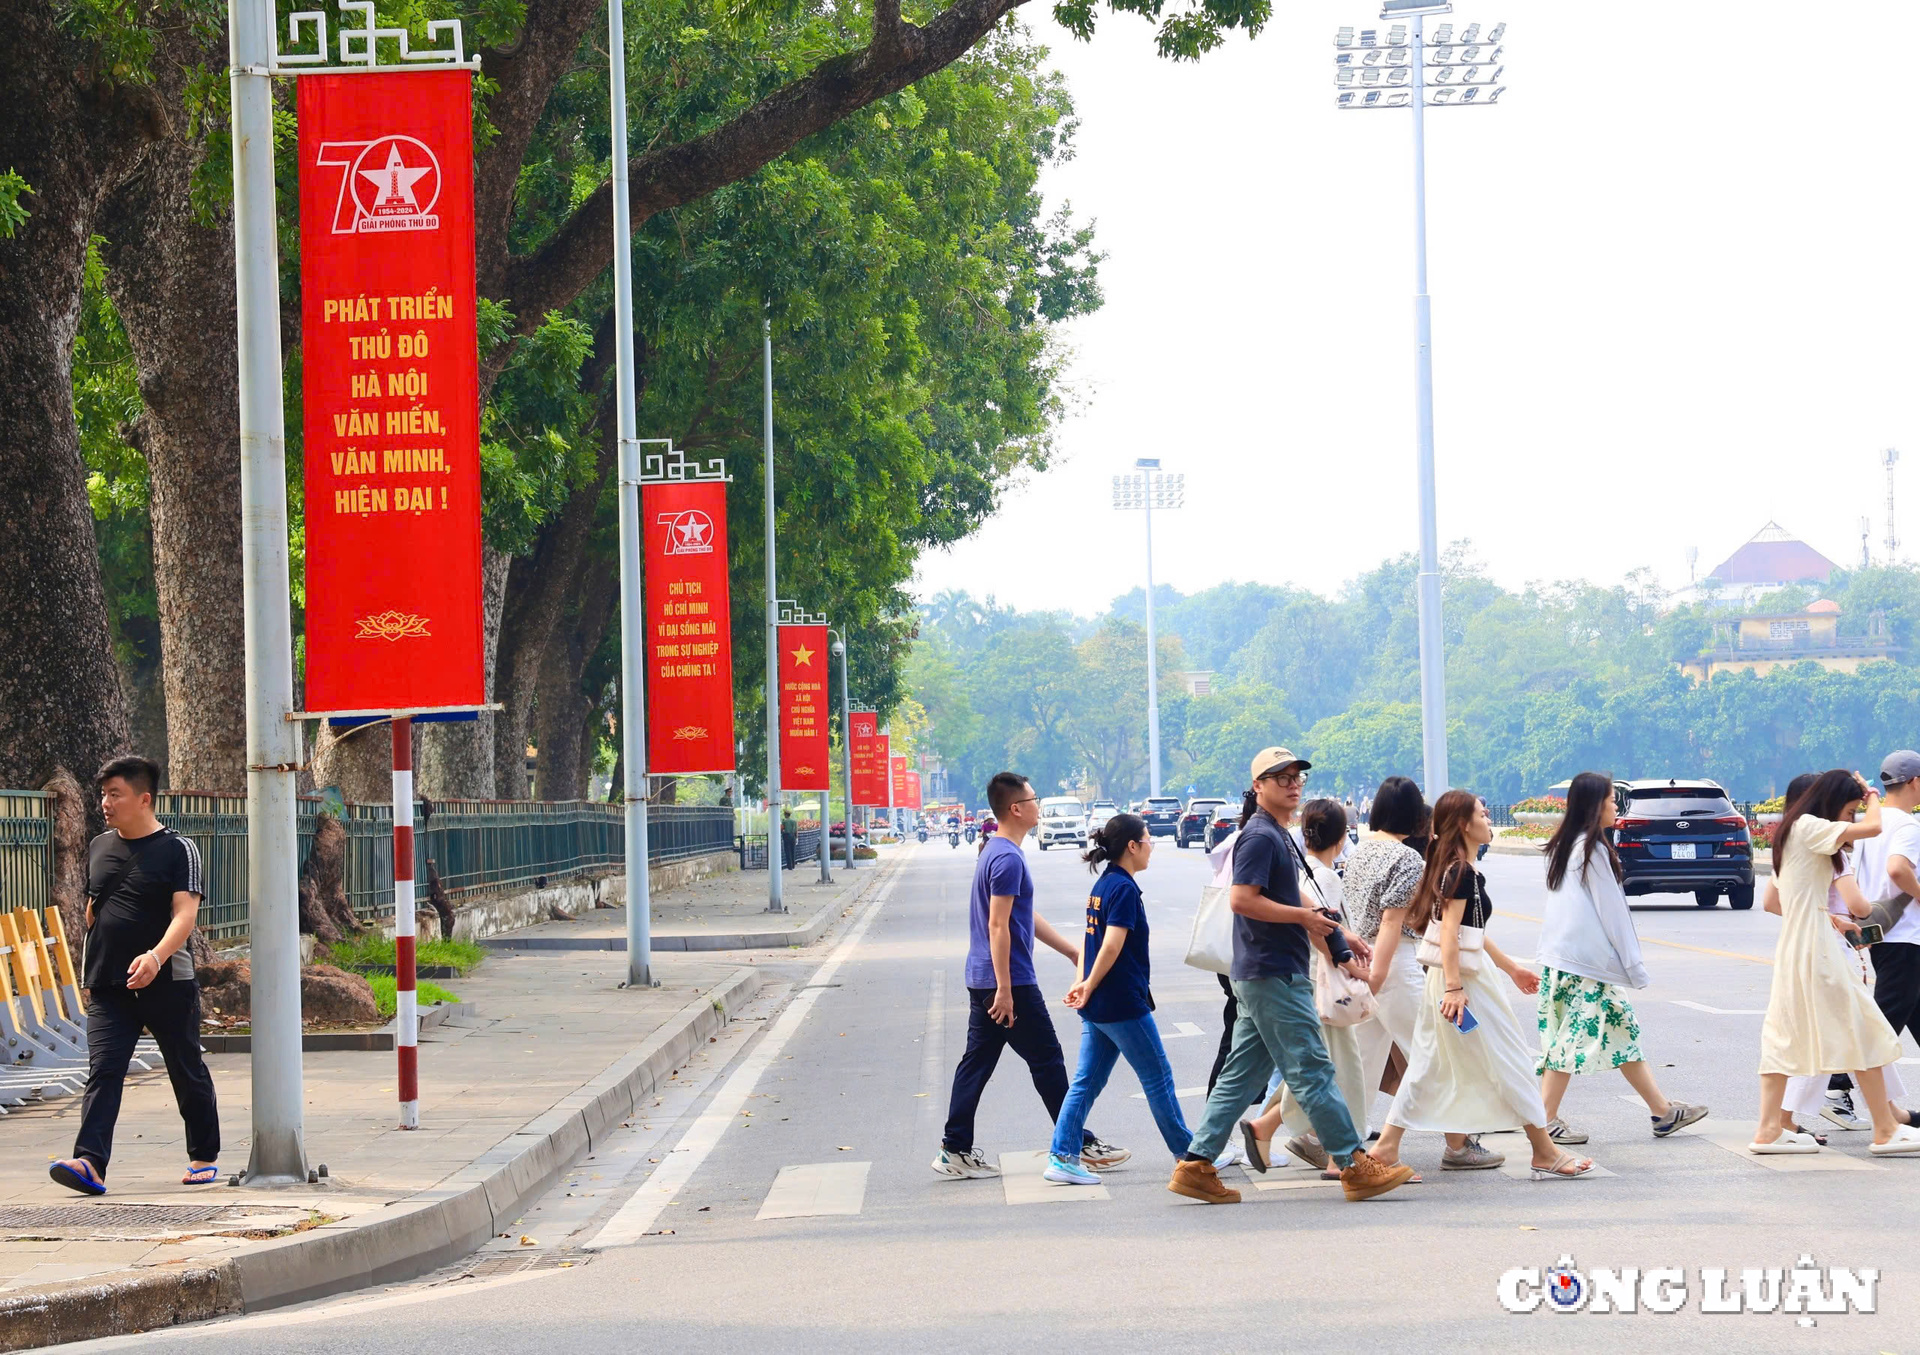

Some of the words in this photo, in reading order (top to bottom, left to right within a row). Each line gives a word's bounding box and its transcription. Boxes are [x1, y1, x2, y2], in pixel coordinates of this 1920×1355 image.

[377, 206, 413, 215] 1954-2024
[361, 218, 378, 230] GIẢI
[380, 218, 407, 229] PHÓNG
[408, 217, 424, 227] THỦ
[426, 217, 437, 227] ĐÔ
[323, 293, 381, 323] PHÁT
[387, 286, 453, 320] TRIỂN
[349, 327, 391, 360] THỦ
[397, 329, 429, 358] ĐÔ
[351, 369, 382, 399] HÀ
[388, 367, 428, 402] NỘI
[333, 408, 379, 438] VĂN
[386, 403, 446, 436] HIẾN,
[330, 446, 376, 476] VĂN
[383, 448, 451, 475] MINH,
[335, 484, 388, 518] HIỆN
[394, 486, 433, 516] ĐẠI
[440, 486, 448, 510] !
[669, 579, 684, 595] CHỦ
[685, 582, 702, 597] TỊCH
[663, 600, 673, 616] HỒ
[675, 600, 688, 615] CHÍ
[689, 602, 709, 615] MINH
[658, 622, 666, 636] VĨ
[666, 624, 679, 639] ĐẠI
[680, 619, 700, 636] SỐNG
[701, 620, 716, 635] MÃI
[656, 644, 679, 658] TRONG
[680, 643, 692, 659] SỰ
[692, 640, 719, 658] NGHIỆP
[661, 661, 676, 678] CỦA
[676, 662, 701, 677] CHÚNG
[702, 663, 712, 676] TA
